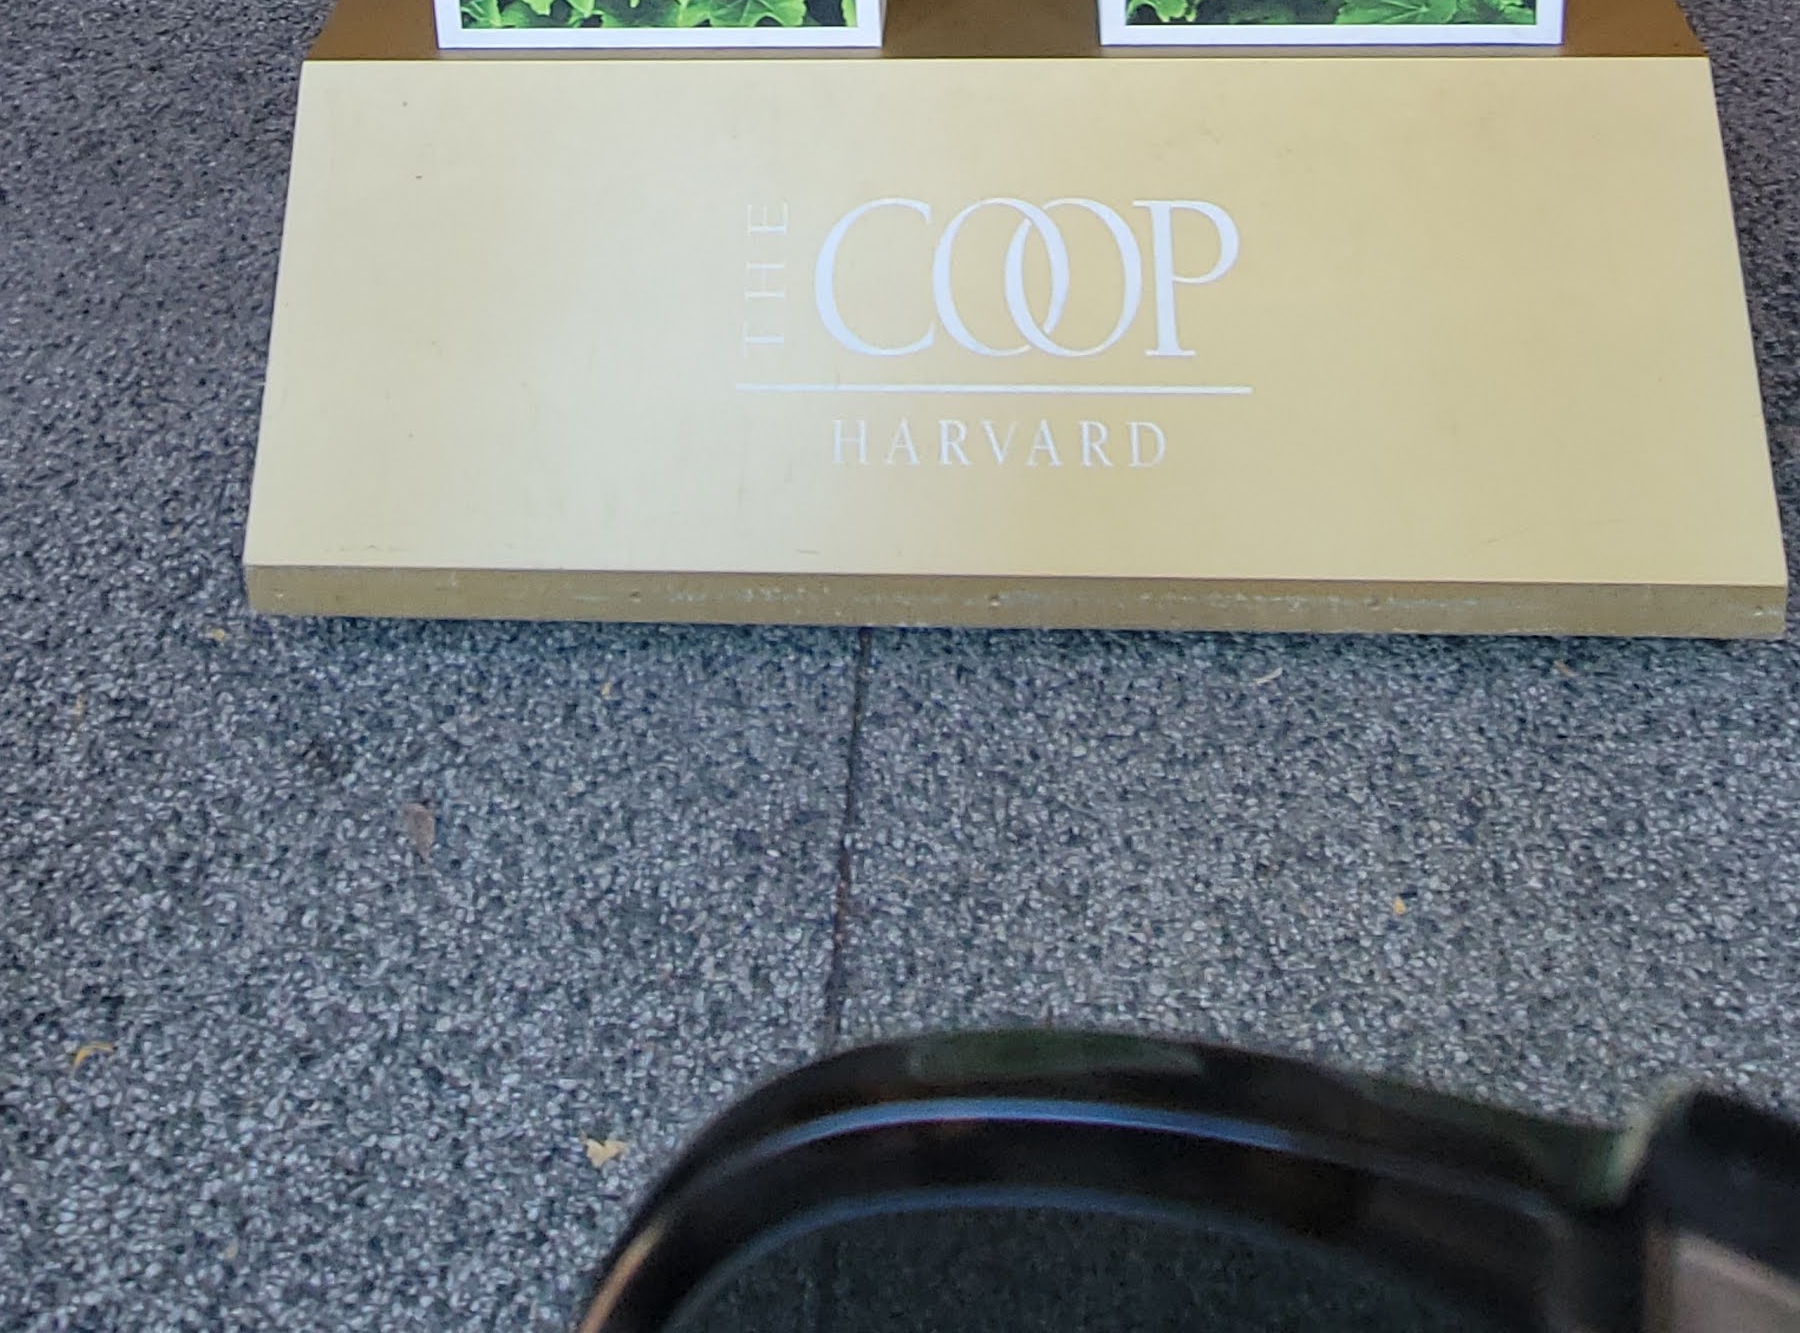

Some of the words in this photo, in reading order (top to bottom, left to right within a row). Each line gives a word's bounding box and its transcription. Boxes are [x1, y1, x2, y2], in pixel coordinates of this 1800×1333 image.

[742, 198, 788, 354] THE
[814, 197, 1241, 357] COOP
[831, 417, 1167, 468] HARVARD
